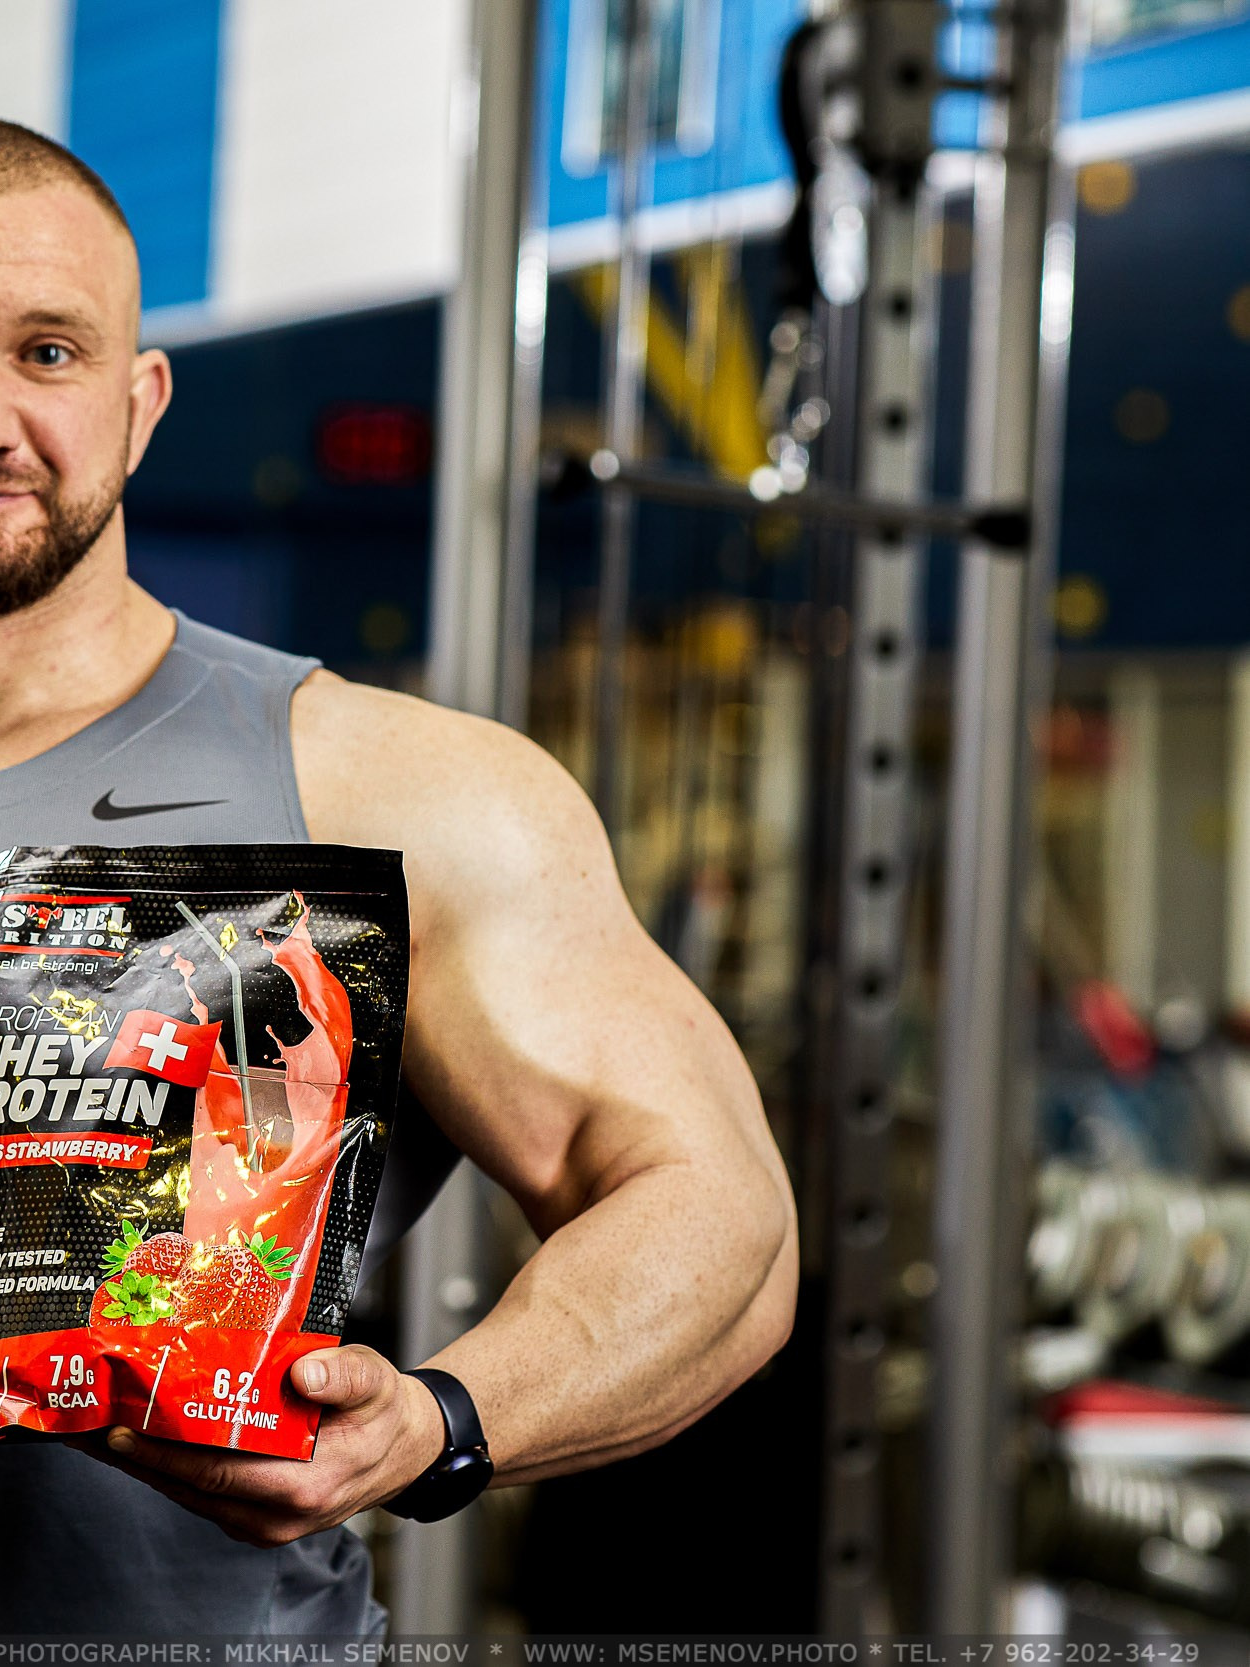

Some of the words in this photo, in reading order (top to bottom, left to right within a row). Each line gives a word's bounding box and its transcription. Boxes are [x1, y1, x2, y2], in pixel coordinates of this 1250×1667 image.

[20, 960, 40, 970] be
[42, 961, 99, 975] strong!
[5, 1140, 139, 1162] STRAWBERRY
[7, 1250, 66, 1268] TESTED
[15, 1275, 95, 1292] FORMULA
[47, 1391, 99, 1409] BCAA
[182, 1401, 280, 1431] GLUTAMINE
